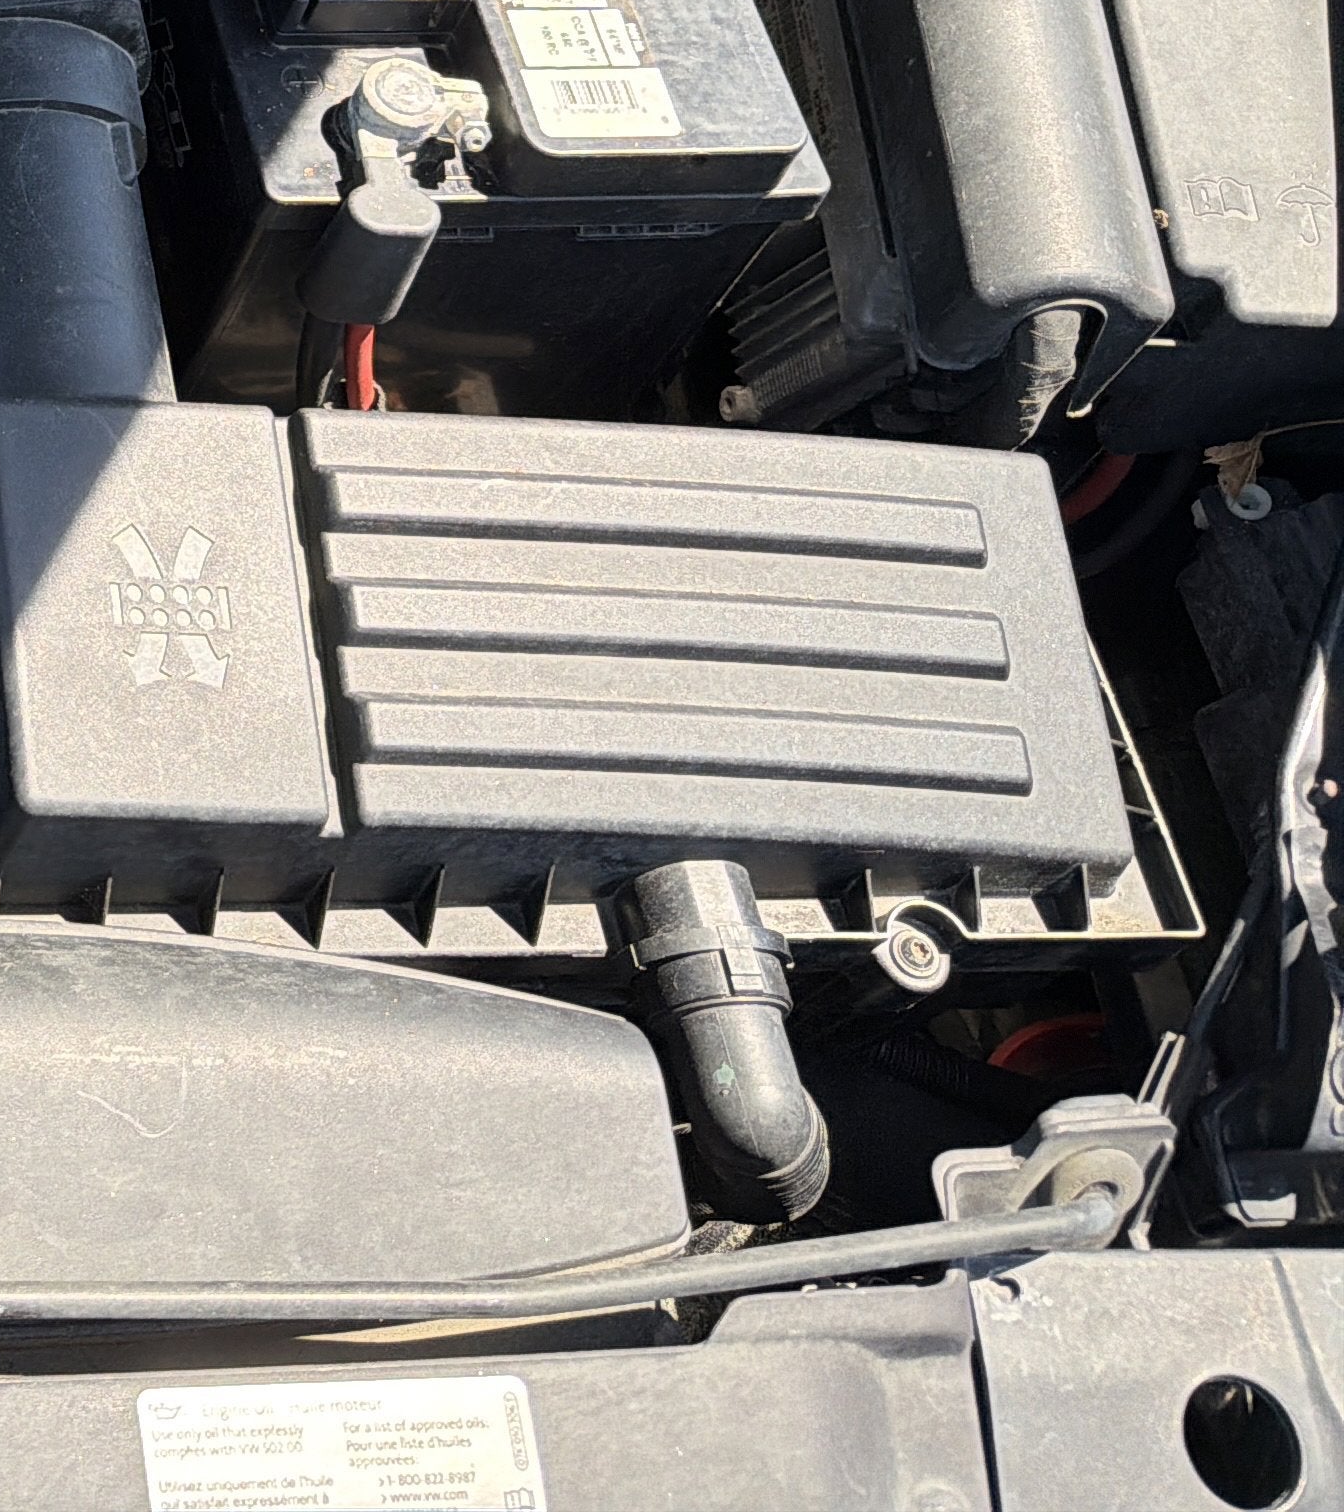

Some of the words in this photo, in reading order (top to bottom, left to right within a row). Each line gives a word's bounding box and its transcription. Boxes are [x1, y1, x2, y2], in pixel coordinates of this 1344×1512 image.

[342, 1421, 361, 1433] For
[364, 1423, 372, 1433] a
[394, 1419, 406, 1432] of
[409, 1418, 463, 1433] approved
[177, 1429, 201, 1442] only
[204, 1427, 219, 1438] oil
[222, 1426, 247, 1438] that
[210, 1444, 236, 1456] with
[263, 1442, 284, 1454] 502
[347, 1439, 373, 1452] Pour
[376, 1441, 397, 1451] une
[206, 1478, 277, 1492] uniquement
[390, 1490, 469, 1503] www.vw.com
